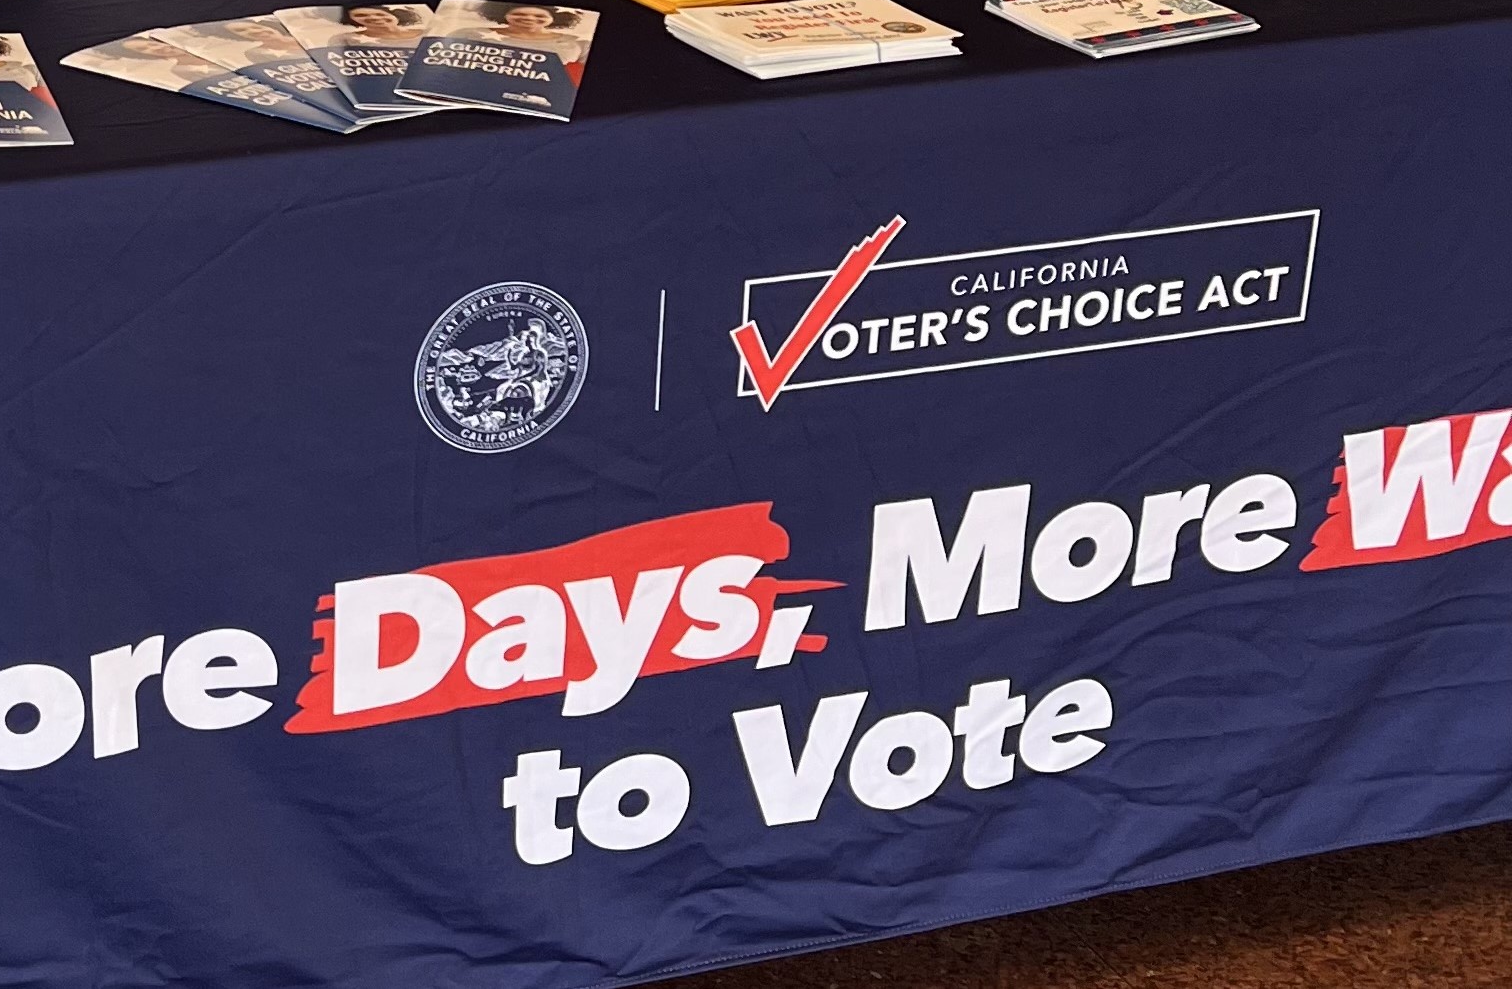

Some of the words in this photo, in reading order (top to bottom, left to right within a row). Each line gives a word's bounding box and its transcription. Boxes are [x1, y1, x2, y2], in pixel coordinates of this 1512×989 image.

[716, 9, 766, 19] WANT
[801, 1, 857, 14] VOTE?
[327, 51, 343, 60] A
[427, 48, 504, 65] VOTING
[508, 58, 533, 69] IN
[429, 41, 444, 50] A
[450, 42, 517, 58] GUIDE
[519, 51, 547, 63] TO
[423, 56, 551, 82] CALIFORNIA
[950, 255, 1130, 297] CALIFORNIA
[1006, 280, 1186, 336] CHOICE
[1197, 266, 1290, 312] ACT
[425, 366, 436, 391] THE
[462, 295, 497, 318] SEAL
[503, 292, 521, 302] OF
[528, 294, 552, 311] THE
[554, 311, 577, 349] STATE
[568, 355, 579, 372] OF
[460, 420, 539, 443] CALIFORNIA
[333, 554, 813, 717] Days,
[864, 473, 1298, 632] More
[502, 749, 691, 866] to
[731, 678, 1114, 827] Vote
